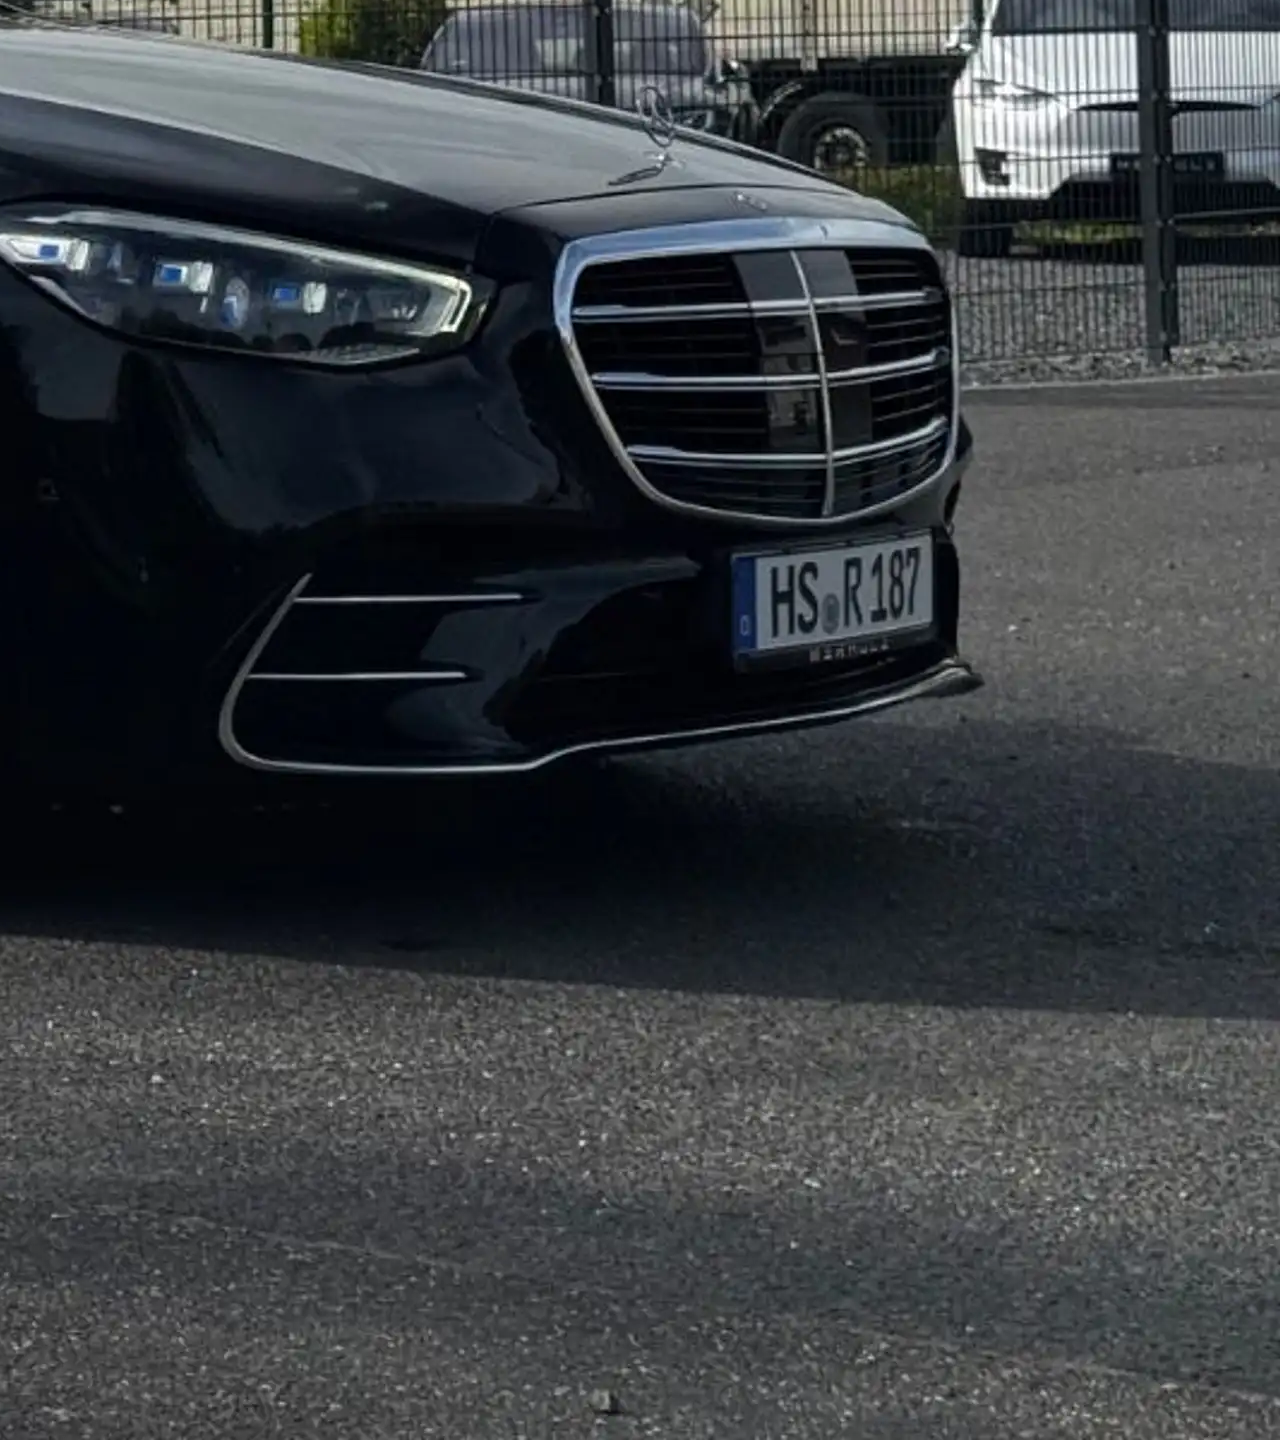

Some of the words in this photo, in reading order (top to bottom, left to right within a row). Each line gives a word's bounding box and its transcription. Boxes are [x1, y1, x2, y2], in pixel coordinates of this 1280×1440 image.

[770, 561, 819, 638] HS
[843, 557, 863, 627] R
[870, 546, 921, 623] 187
